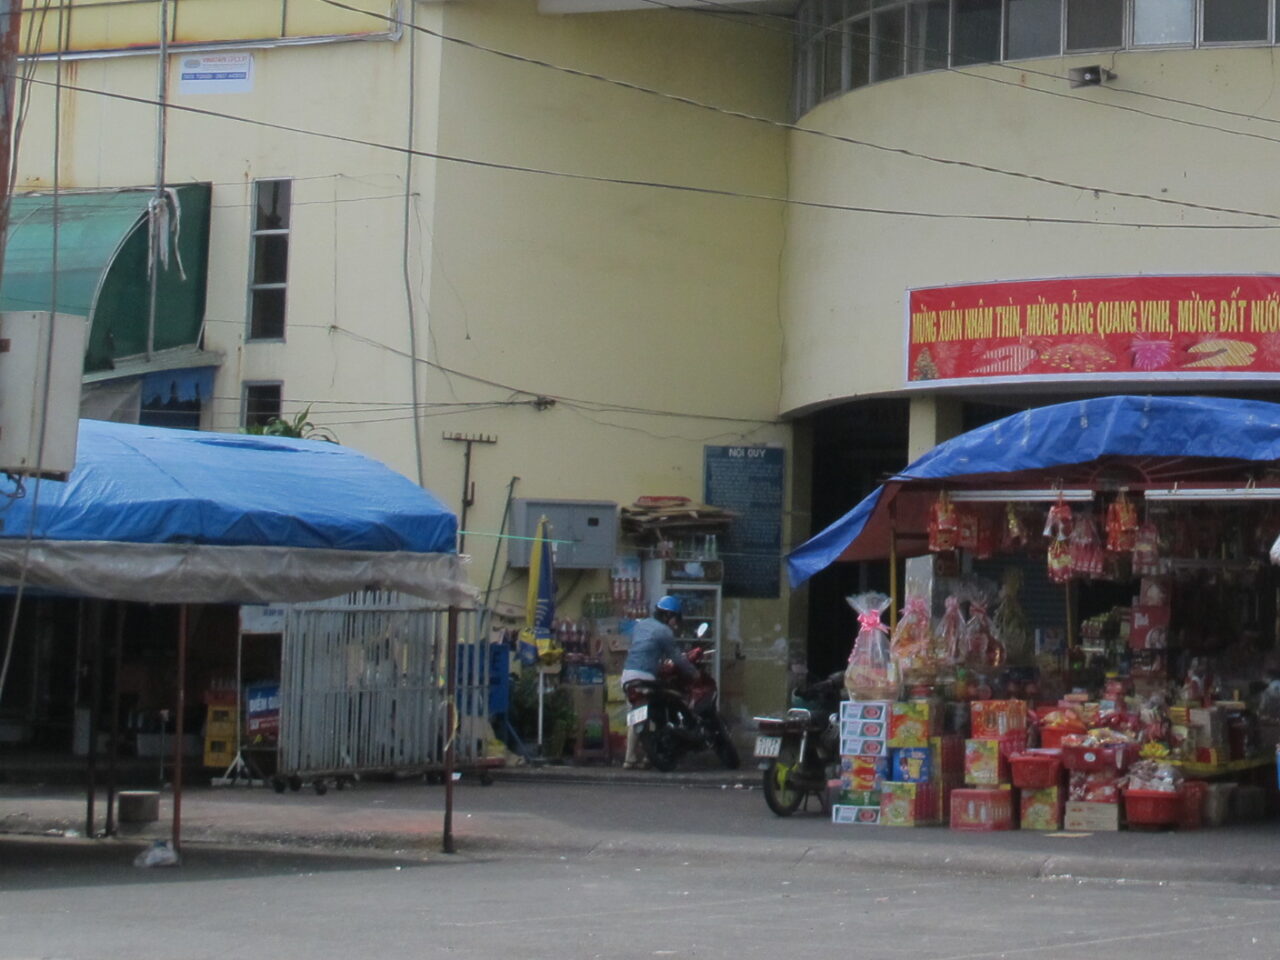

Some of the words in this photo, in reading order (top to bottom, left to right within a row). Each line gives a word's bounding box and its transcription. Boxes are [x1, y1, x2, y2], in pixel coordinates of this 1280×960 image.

[939, 301, 963, 342] XUÂN
[965, 298, 993, 341] NHÂM
[1026, 295, 1059, 338] MỪNG
[1062, 289, 1094, 335] ĐẢNG
[1097, 300, 1137, 339] QUANG
[1140, 299, 1174, 340] VINH,
[1177, 291, 1216, 333] MỪNG
[1219, 286, 1247, 333] ĐẤT
